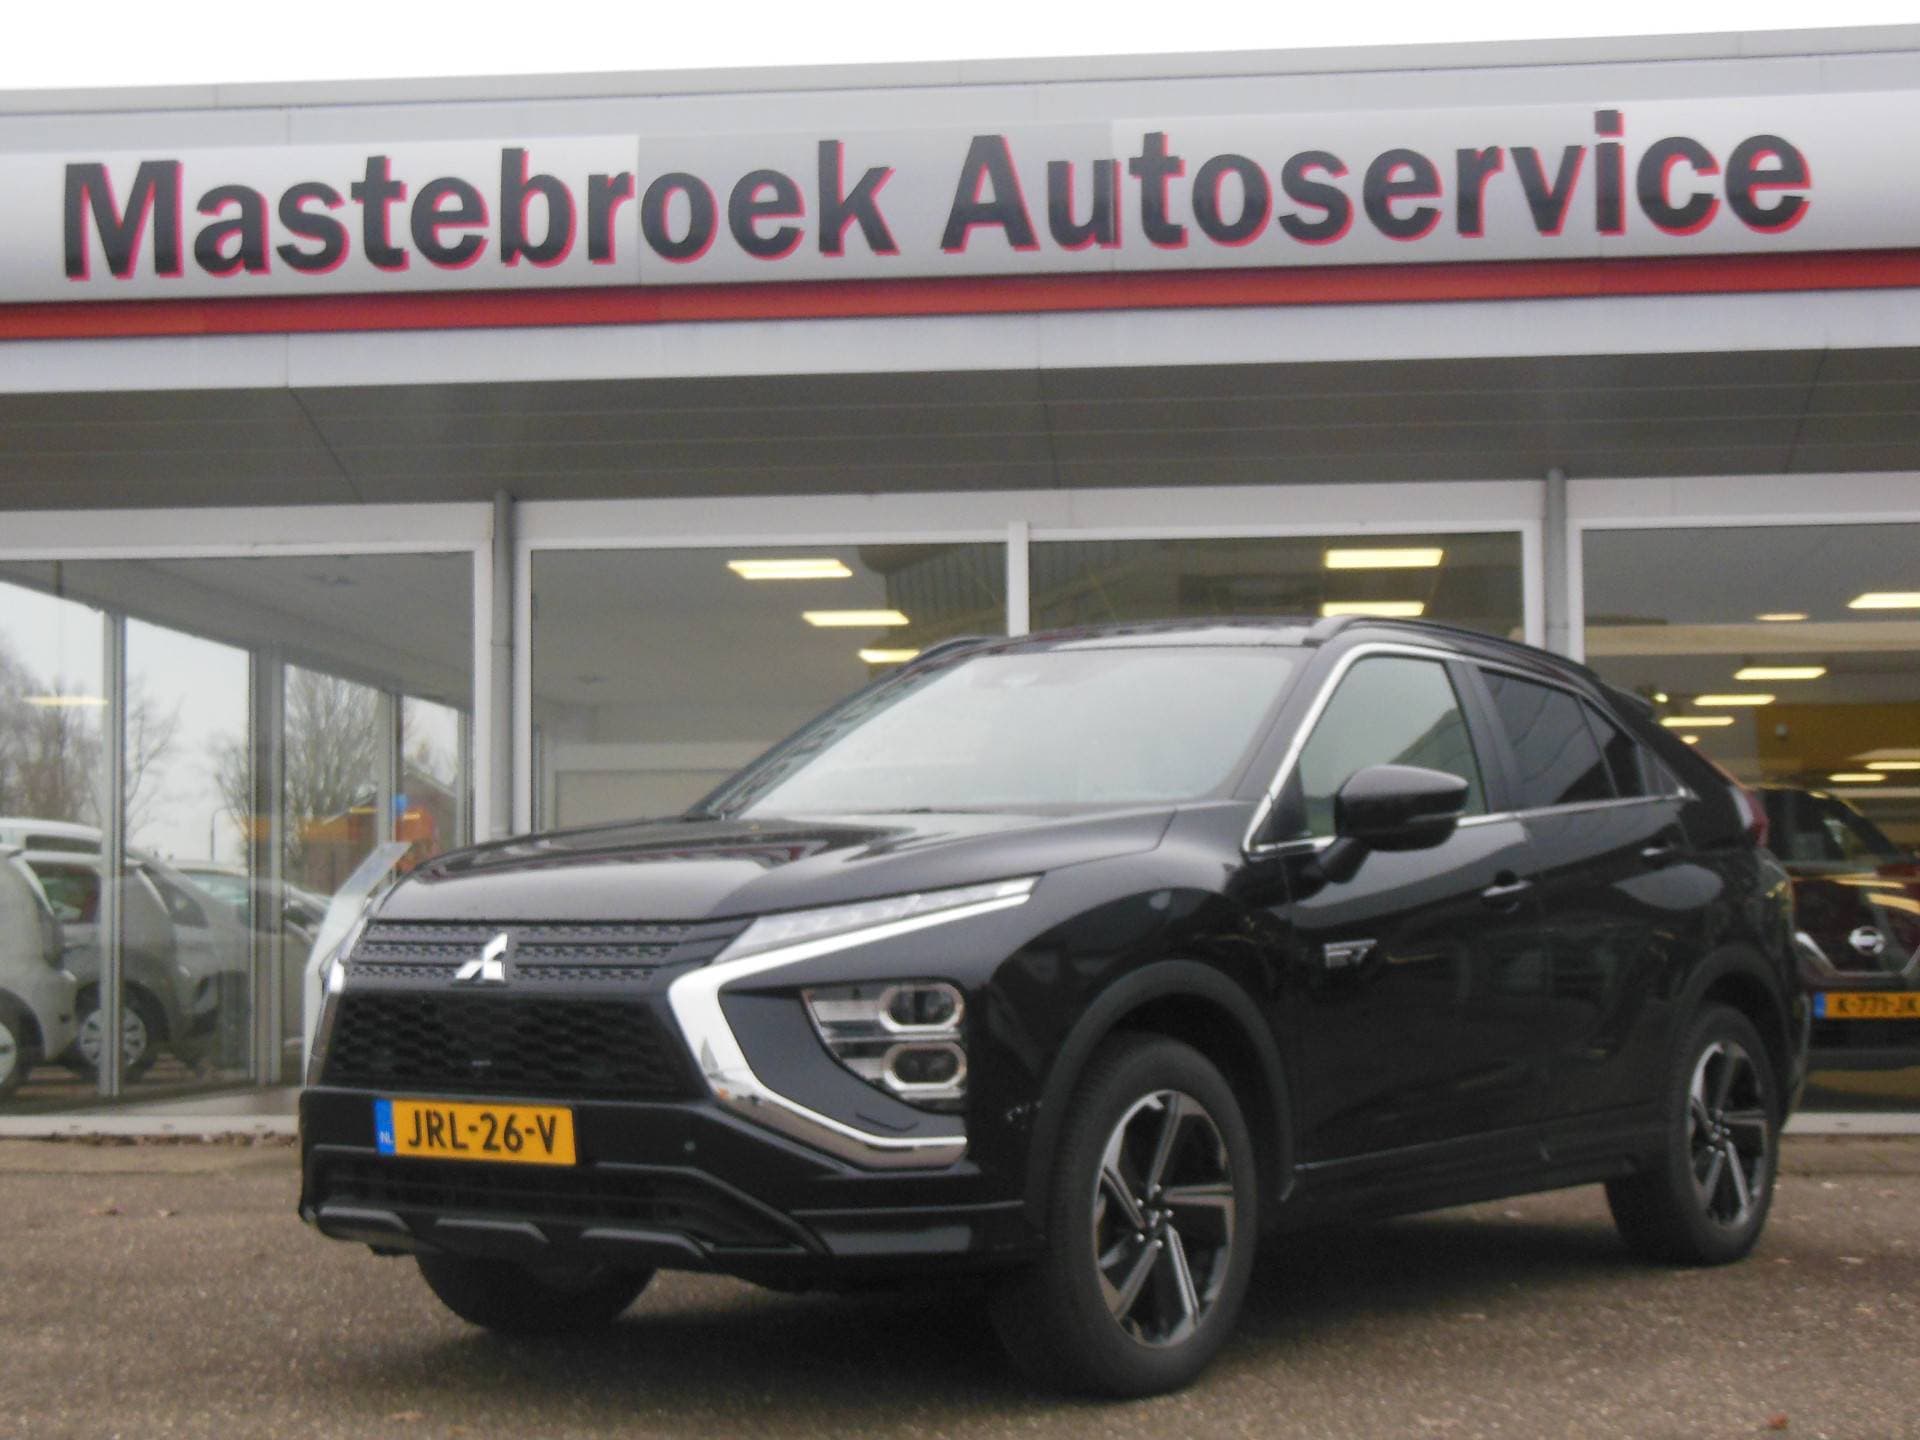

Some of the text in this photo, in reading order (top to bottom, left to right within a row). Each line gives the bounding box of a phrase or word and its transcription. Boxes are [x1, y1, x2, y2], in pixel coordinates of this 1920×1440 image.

[65, 109, 1812, 281] Mastebroek Autoservice
[408, 1108, 557, 1155] JRL-26-V
